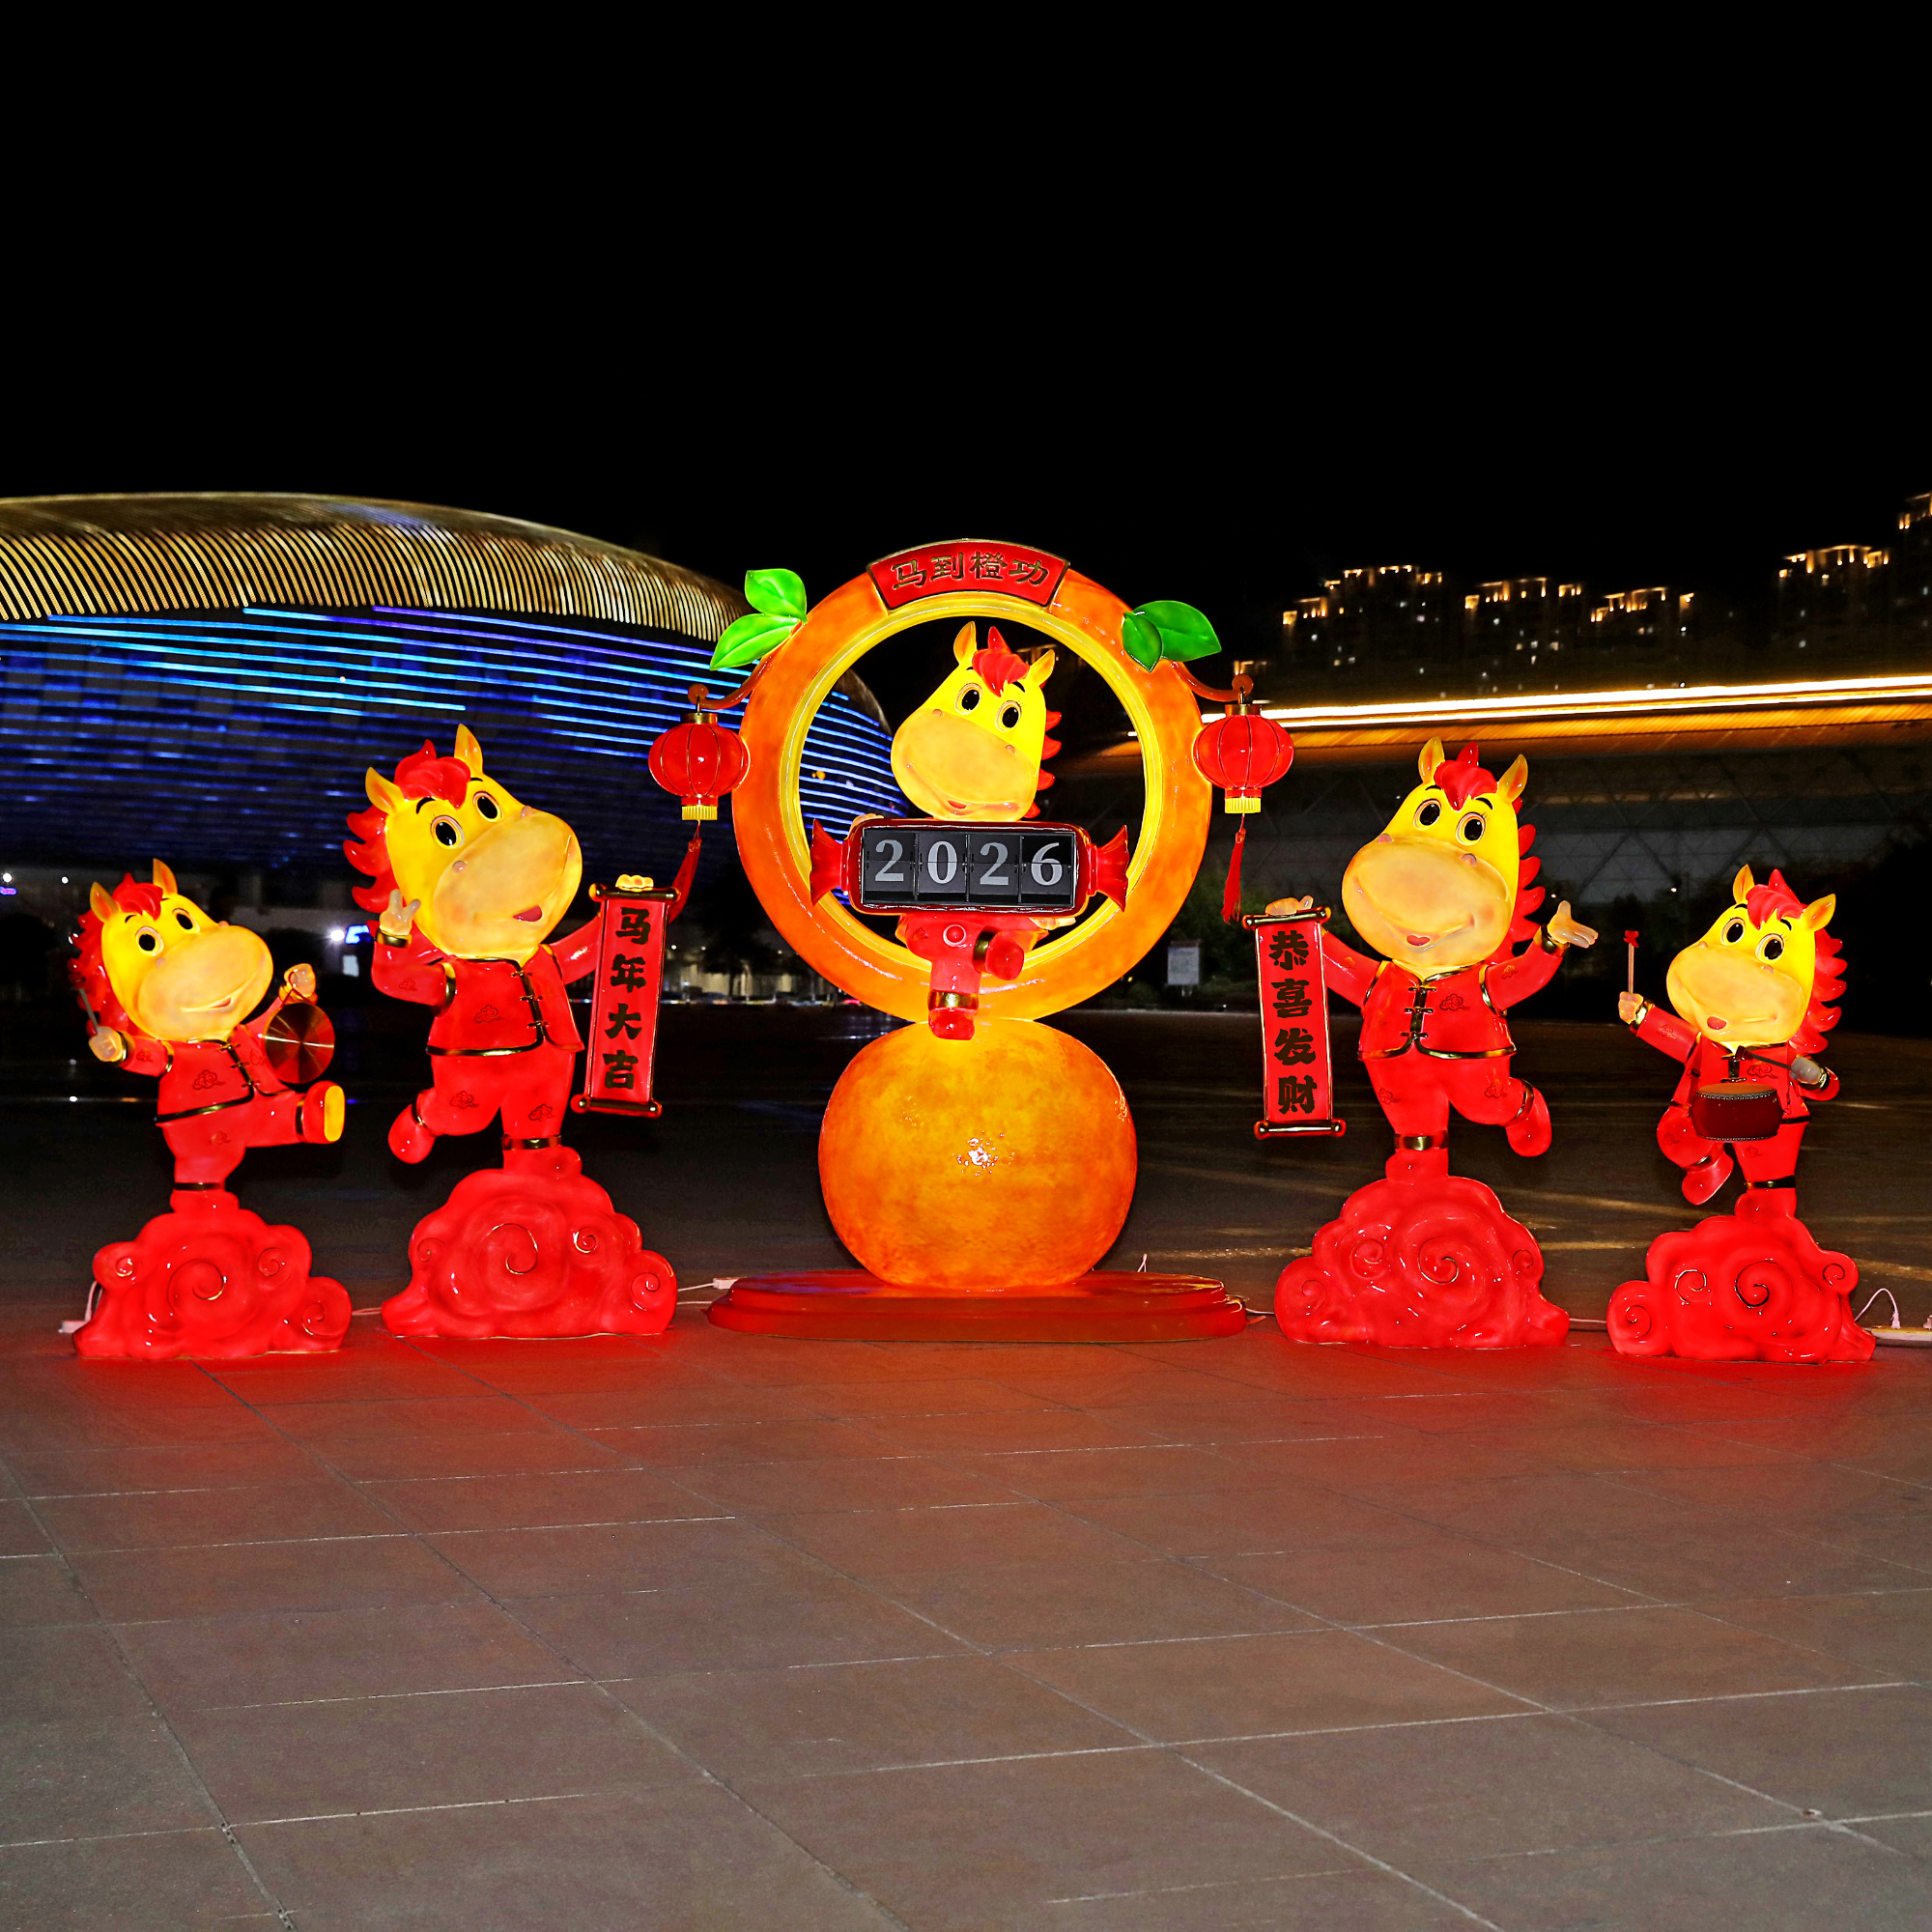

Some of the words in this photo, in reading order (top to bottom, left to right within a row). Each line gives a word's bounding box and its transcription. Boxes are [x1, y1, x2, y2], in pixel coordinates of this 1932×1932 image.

[891, 552, 1049, 590] 马到橙功
[875, 838, 1064, 886] 2026
[603, 906, 651, 1090] 马年大吉
[1268, 929, 1318, 1115] 恭喜发财
